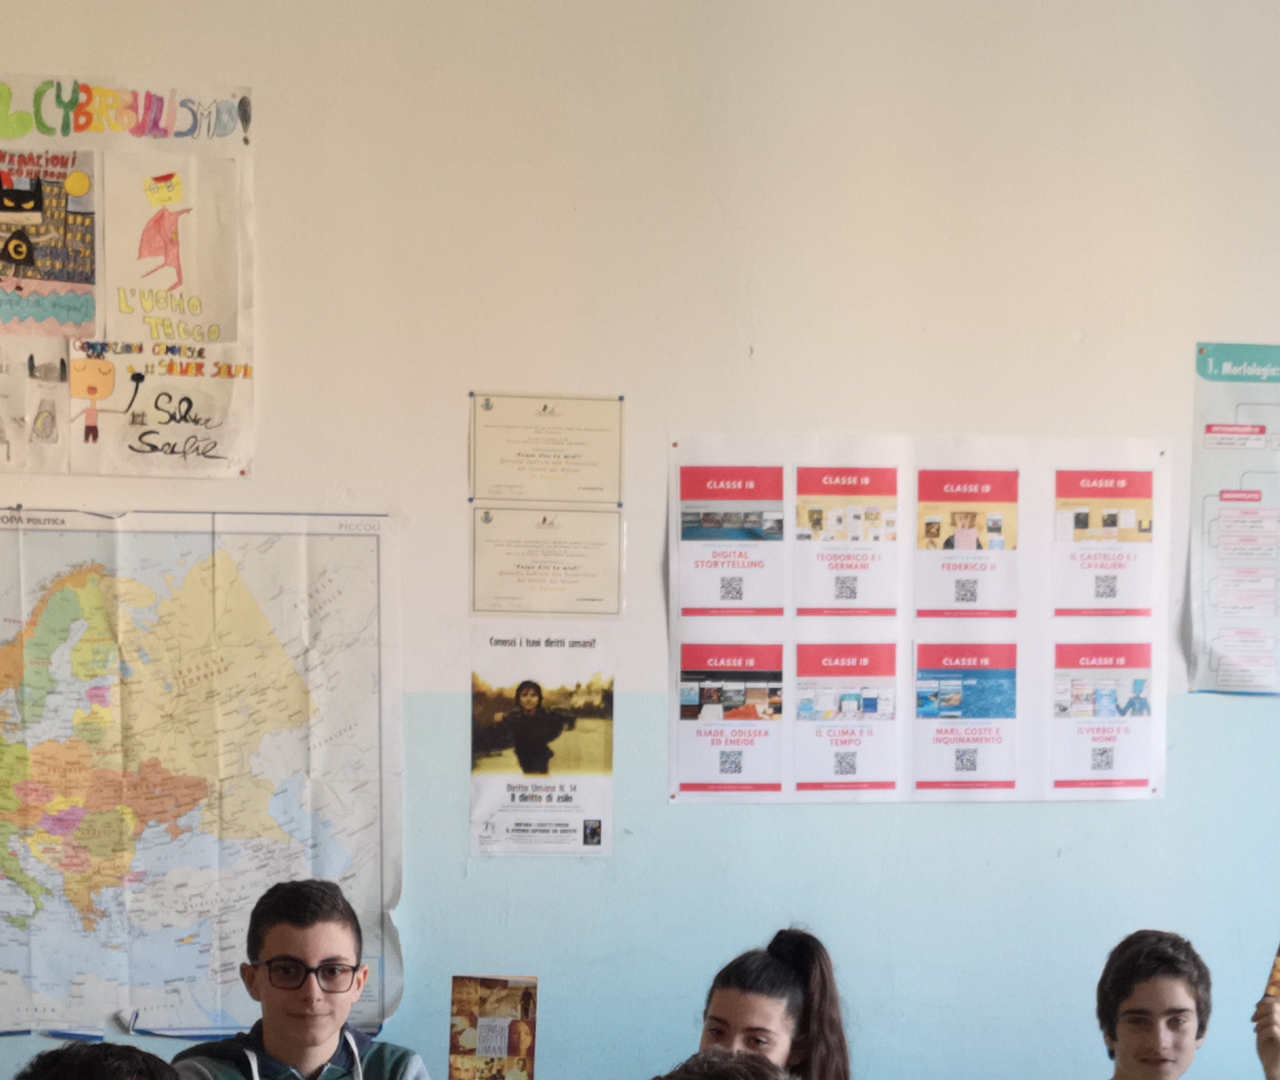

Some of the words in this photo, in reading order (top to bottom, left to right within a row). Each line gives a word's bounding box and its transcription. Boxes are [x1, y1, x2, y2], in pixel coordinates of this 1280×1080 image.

[118, 287, 203, 316] L'UOMO
[1208, 358, 1218, 375] 1.
[1222, 362, 1280, 380] Morfologia:
[706, 480, 743, 490] CLASSE
[822, 475, 859, 486] CLASSE
[1079, 479, 1115, 488] CLASSE
[943, 484, 979, 493] CLASSE
[26, 517, 66, 526] POLITICA
[712, 551, 749, 559] DIGITAL
[816, 553, 869, 562] TEODORICO
[1079, 553, 1124, 561] CASTELLO
[694, 560, 765, 569] STORYTELLING
[827, 562, 870, 571] GERMANI
[941, 563, 988, 571] FEDERICO
[990, 563, 996, 571] II
[1080, 561, 1127, 570] CAVALIERI
[489, 637, 517, 648] Conosci
[525, 637, 541, 648] tuoi
[544, 637, 565, 648] diritti
[707, 658, 743, 667] CLASSE
[822, 657, 858, 666] CLASSE
[942, 657, 978, 666] CLASSE
[1078, 657, 1114, 666] CLASSE
[730, 729, 769, 737] ODISSEA
[815, 729, 823, 738] IL
[826, 729, 856, 738] CLIMA
[867, 729, 874, 738] IL
[964, 728, 993, 736] COSTE
[710, 738, 722, 746] ED
[724, 738, 756, 747] ENEIDE
[829, 738, 862, 747] TEMPO
[933, 736, 1003, 745] INQUINAMENTO
[1091, 735, 1117, 743] NOME
[506, 784, 528, 793] Diritto
